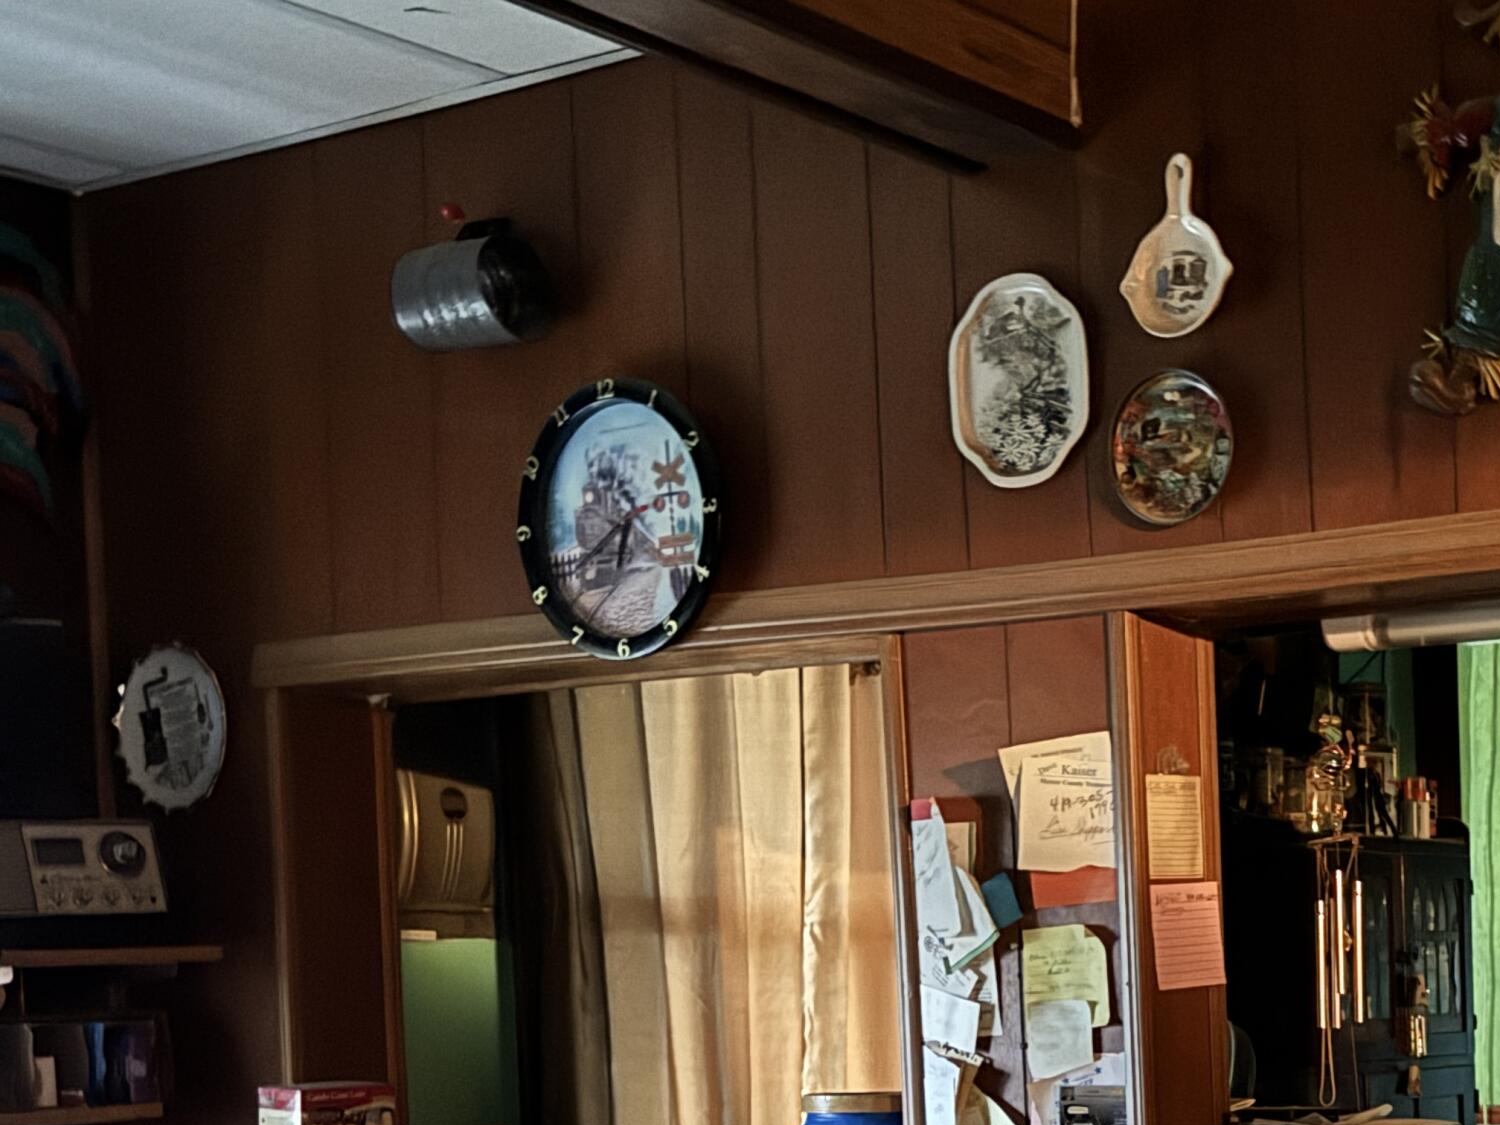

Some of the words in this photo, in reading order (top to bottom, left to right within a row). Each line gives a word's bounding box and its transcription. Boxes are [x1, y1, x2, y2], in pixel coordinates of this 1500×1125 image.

[596, 378, 614, 400] 12
[701, 497, 718, 514] 3
[516, 525, 531, 542] 9
[693, 564, 710, 582] 4
[532, 585, 548, 605] 8
[571, 625, 585, 645] 7
[662, 619, 679, 637] 5
[617, 638, 630, 658] 6
